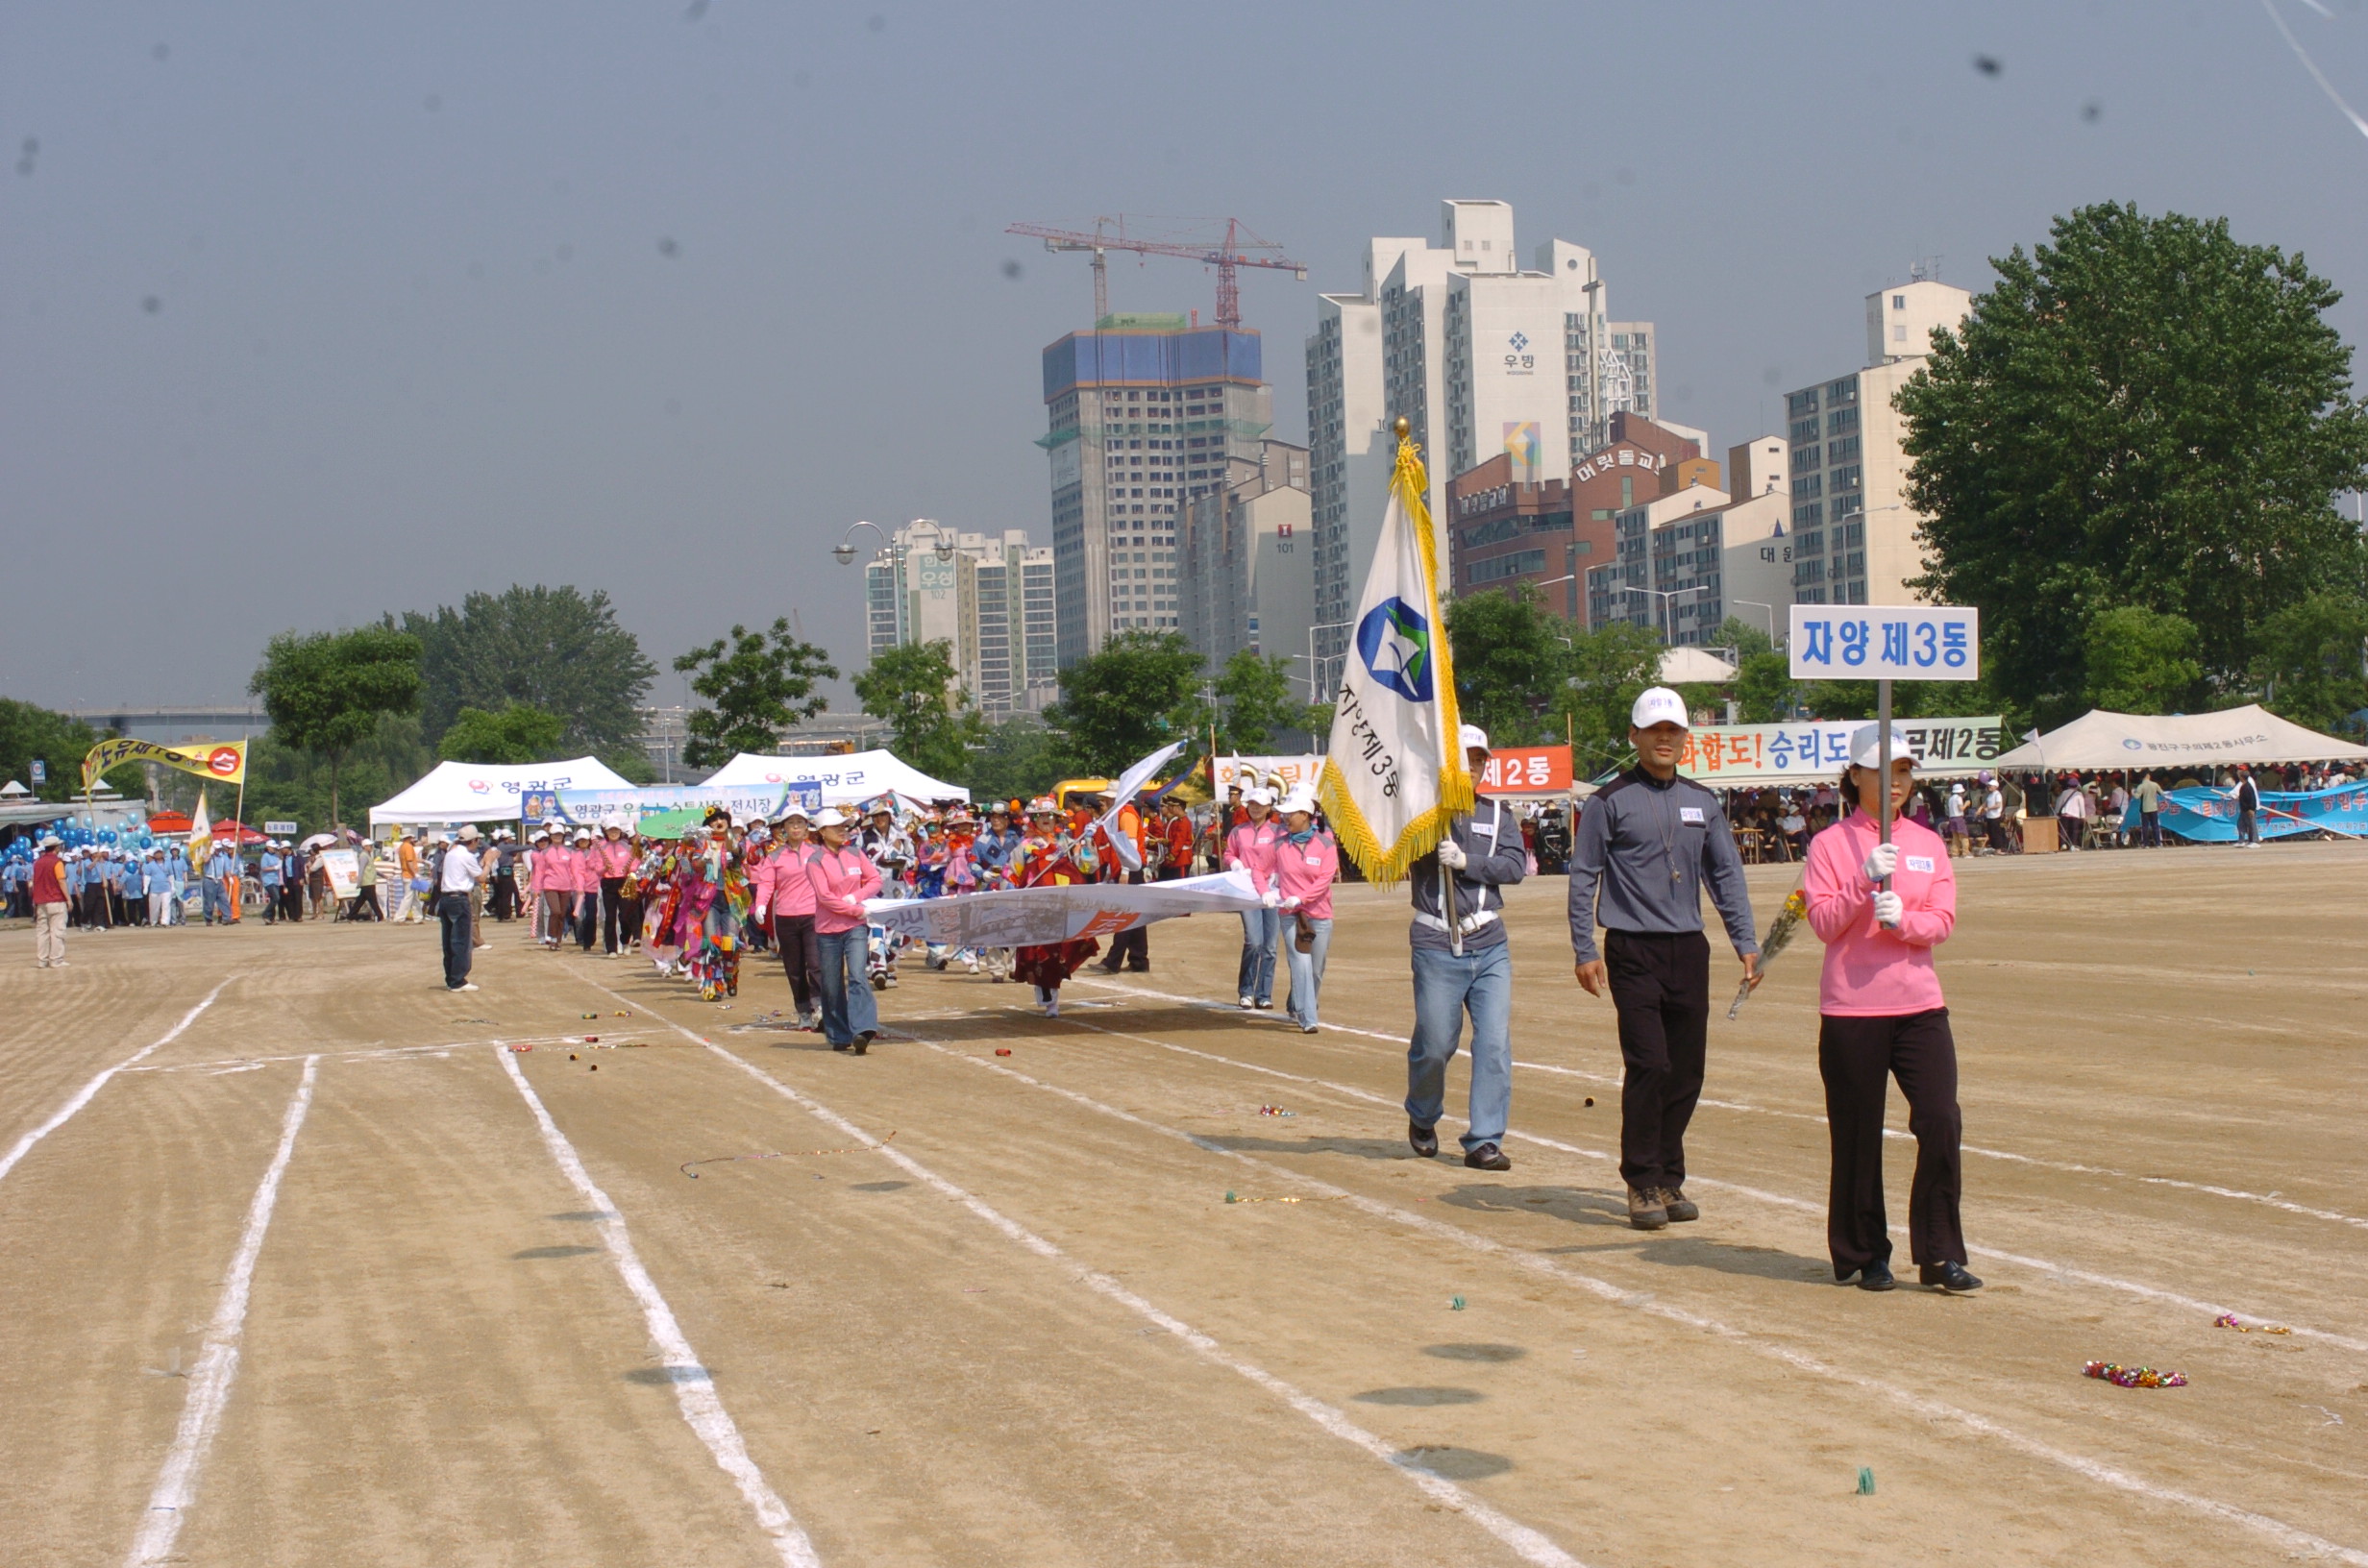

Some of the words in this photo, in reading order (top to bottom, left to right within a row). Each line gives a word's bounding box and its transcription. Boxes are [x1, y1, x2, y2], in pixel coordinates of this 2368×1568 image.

[1504, 355, 1534, 369] 우방
[1276, 543, 1294, 553] 101
[931, 589, 947, 600] 102
[1340, 683, 1398, 799] 자양제3동
[1481, 755, 1551, 788] 제2동
[501, 776, 573, 795] 영광군
[730, 796, 772, 815] 전시장
